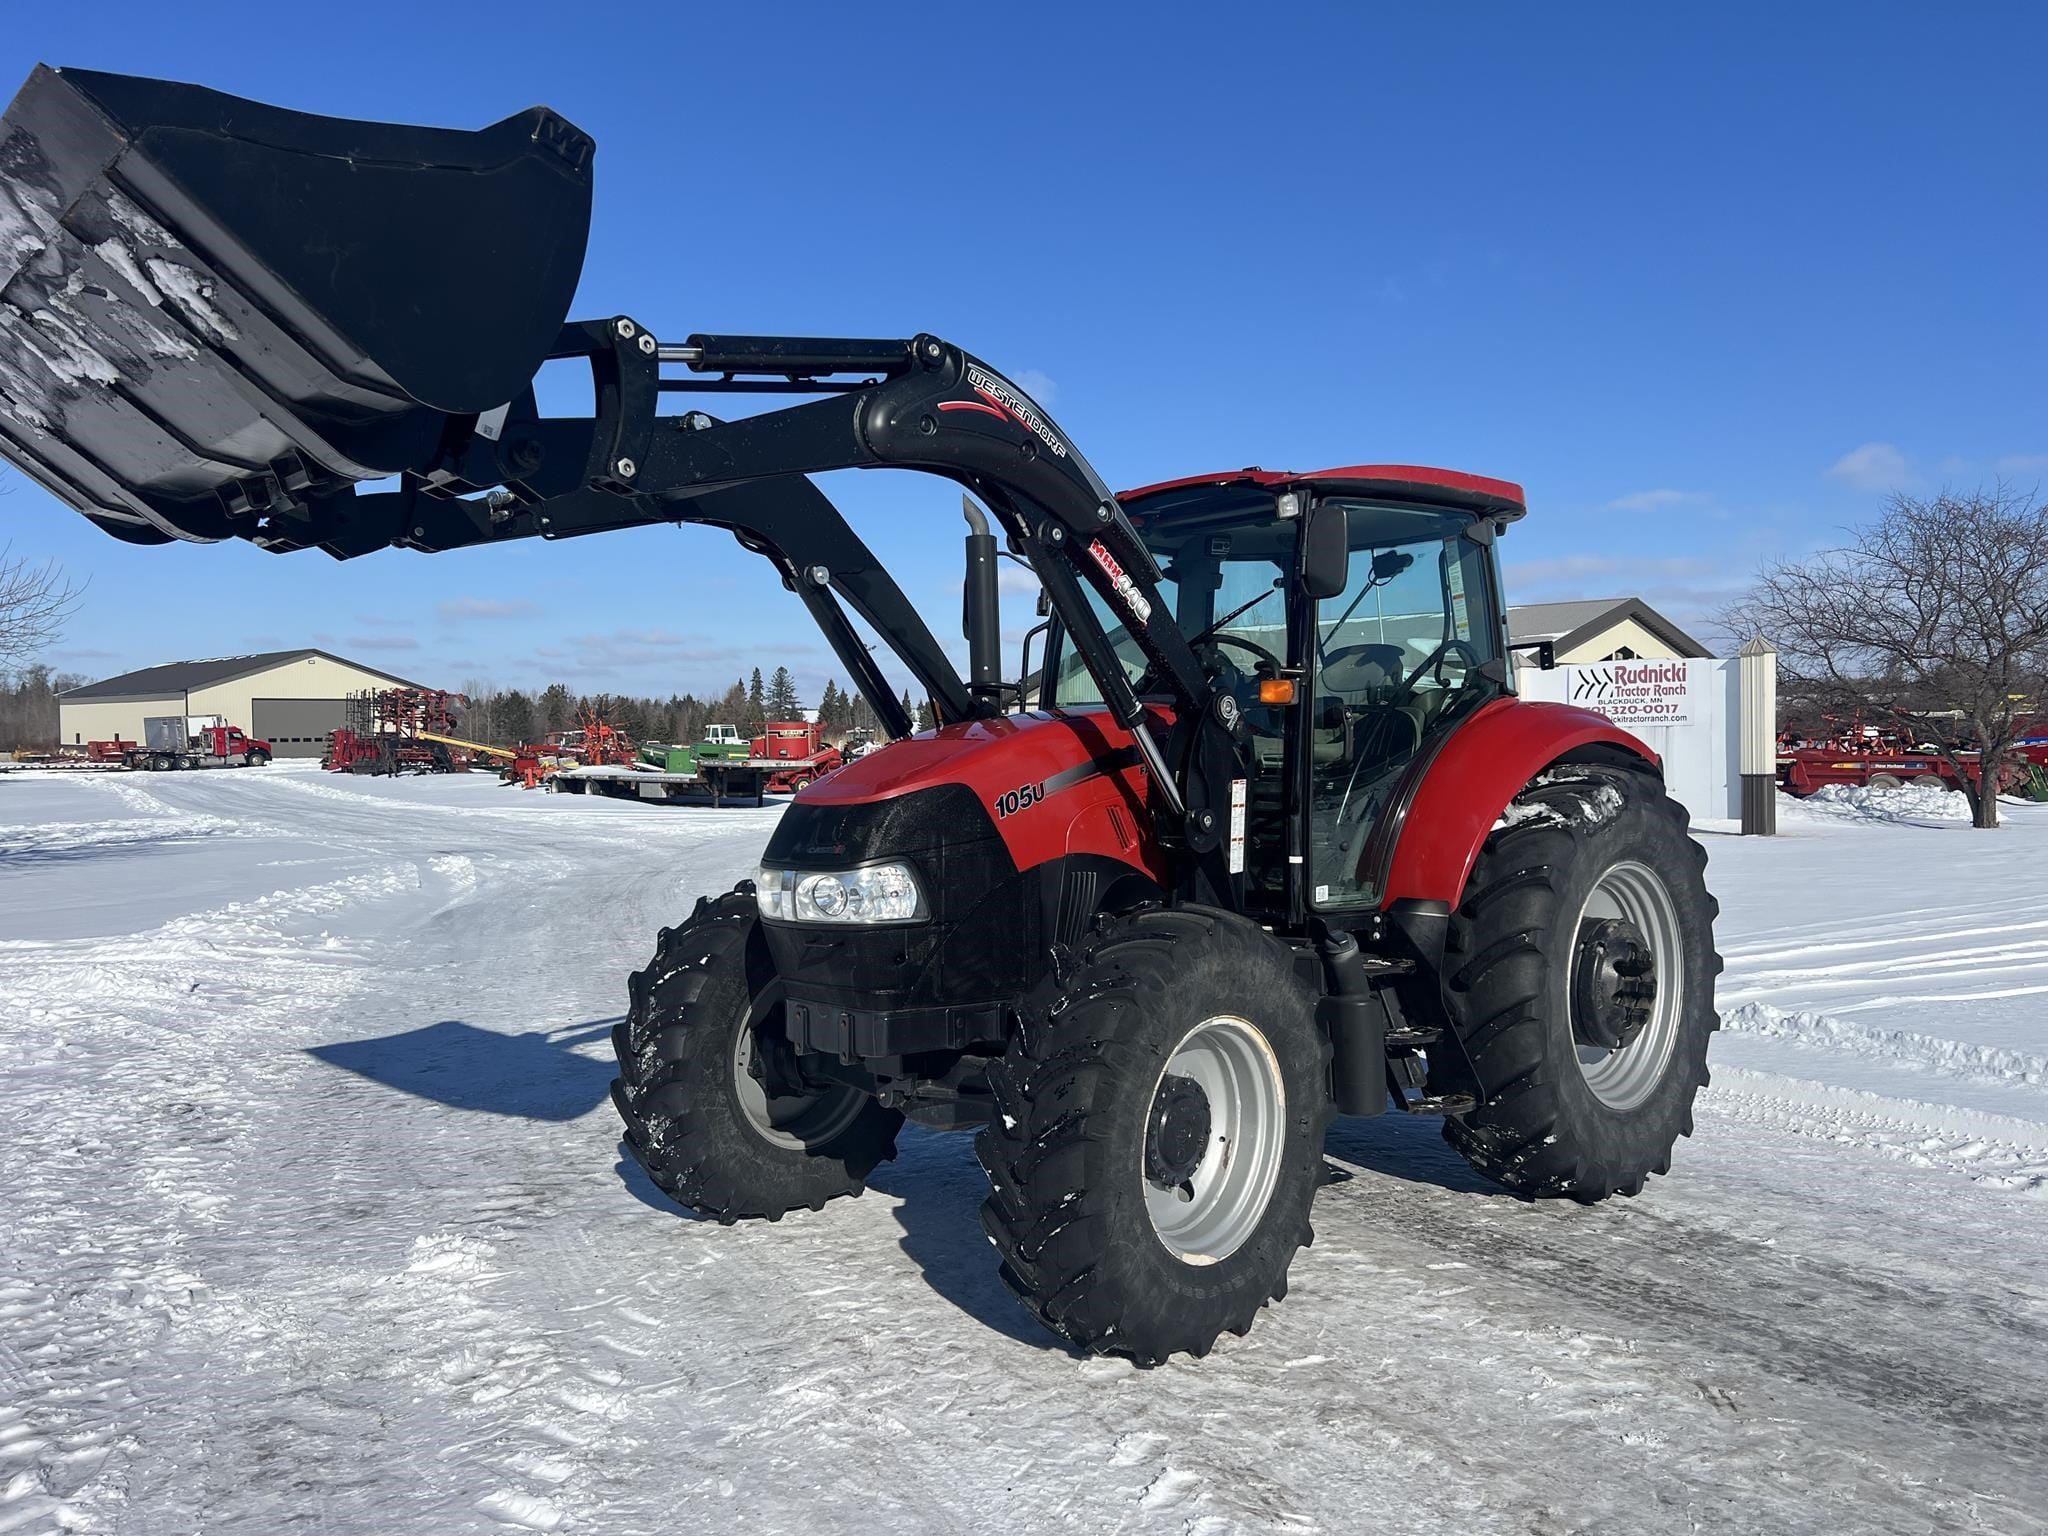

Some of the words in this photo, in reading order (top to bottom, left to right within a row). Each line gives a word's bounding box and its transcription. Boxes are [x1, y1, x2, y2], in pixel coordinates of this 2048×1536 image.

[967, 369, 1066, 458] WESTENDORF
[1615, 663, 1686, 686] Rudnicki
[1615, 686, 1650, 698] Tractor
[1654, 684, 1686, 696] Ranch
[994, 780, 1046, 820] 105U
